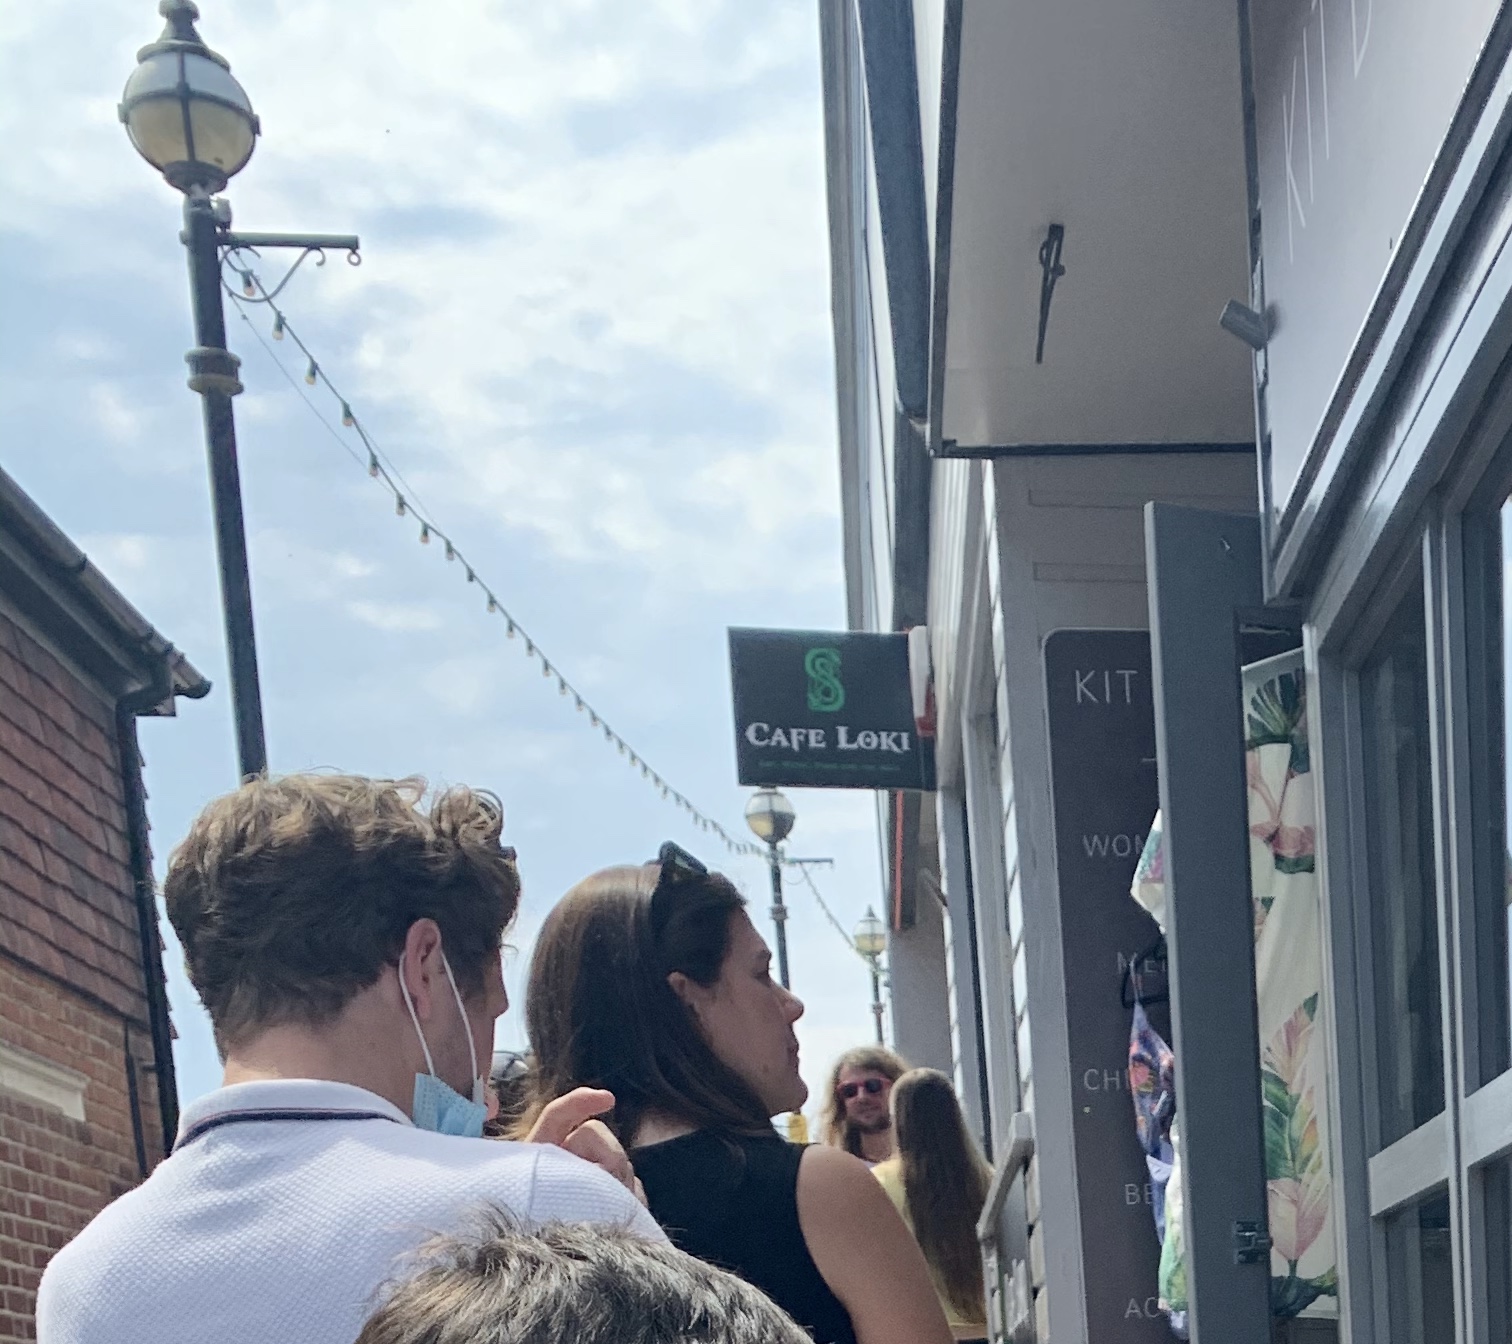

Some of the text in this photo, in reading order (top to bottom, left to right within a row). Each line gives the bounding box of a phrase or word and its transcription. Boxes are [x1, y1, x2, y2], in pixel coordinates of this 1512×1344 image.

[1075, 669, 1139, 704] KIT
[745, 721, 912, 754] CAFE LOKI
